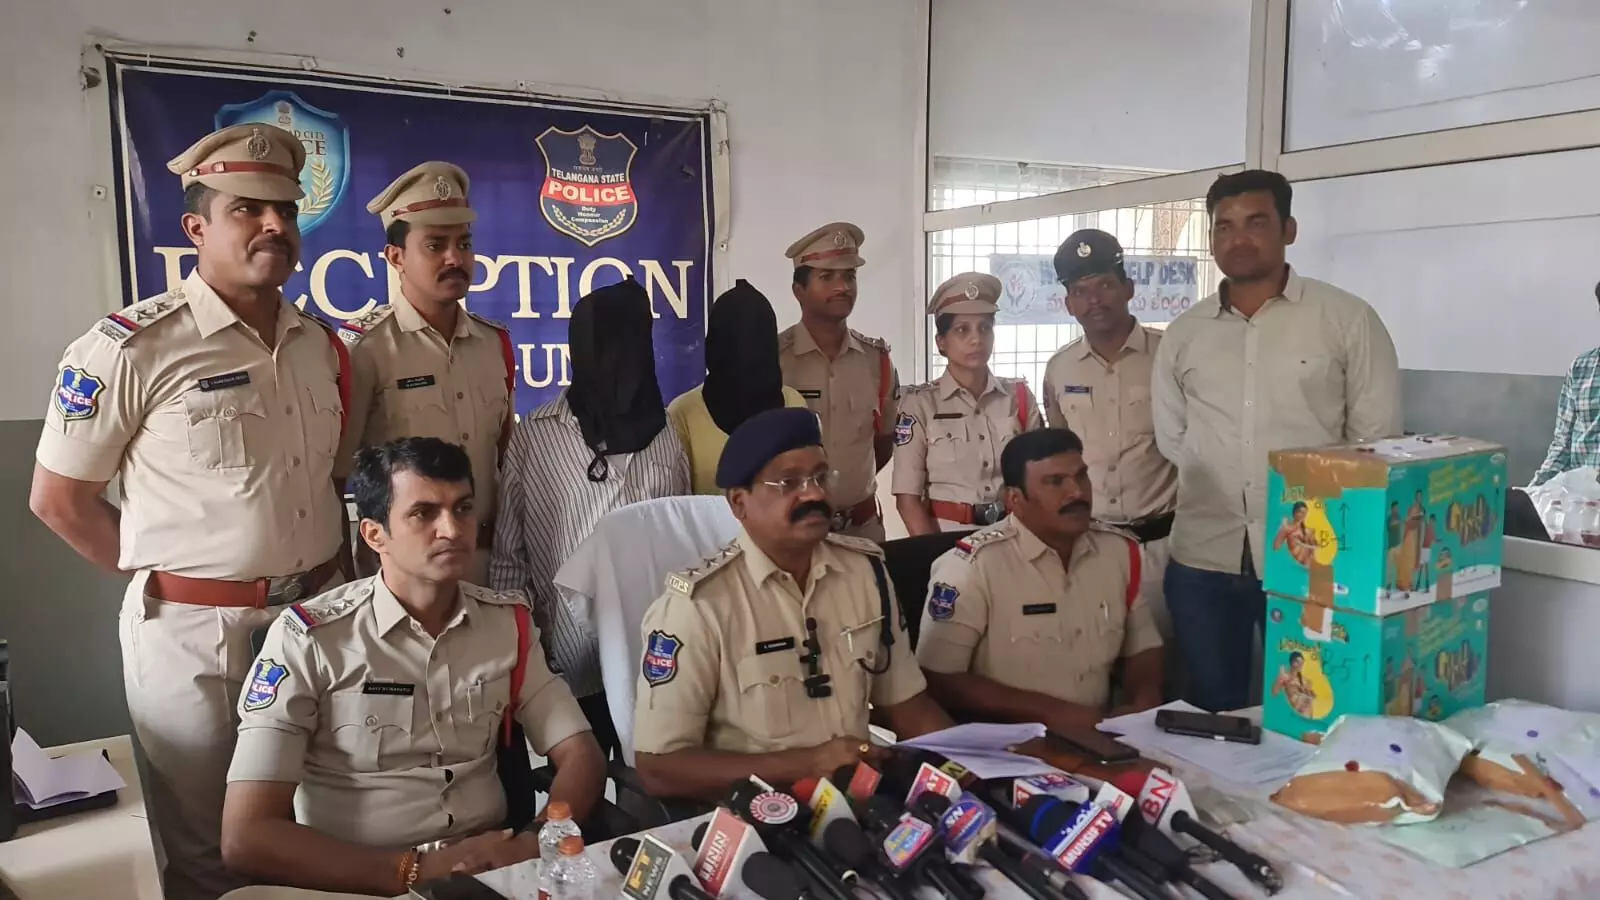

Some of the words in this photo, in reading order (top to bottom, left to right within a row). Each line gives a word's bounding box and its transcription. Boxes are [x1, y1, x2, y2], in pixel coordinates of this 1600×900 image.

[548, 180, 631, 203] POLICE
[551, 168, 600, 184] TELANGANA
[601, 173, 625, 184] STATE
[153, 246, 694, 320] CPTION
[1158, 262, 1197, 285] DESK
[1062, 827, 1100, 866] MUNSIF
[1098, 809, 1115, 829] TV
[642, 856, 664, 896] NEWS
